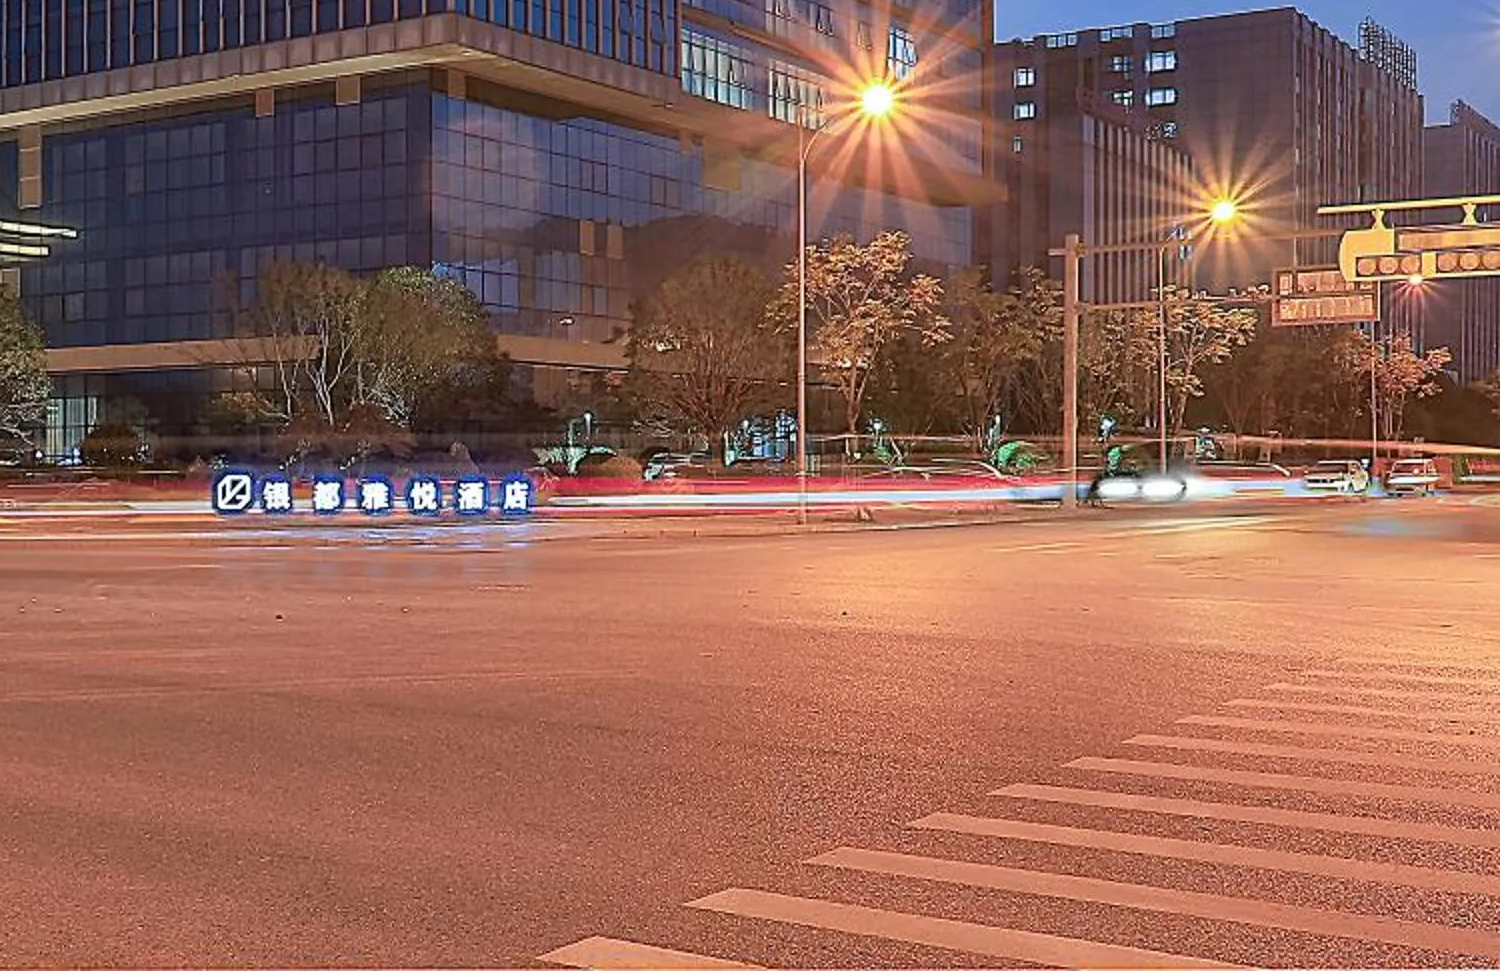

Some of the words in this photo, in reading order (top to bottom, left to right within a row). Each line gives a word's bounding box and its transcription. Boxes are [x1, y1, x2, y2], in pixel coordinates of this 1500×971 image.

[264, 481, 528, 510] 银都雅悦酒店
